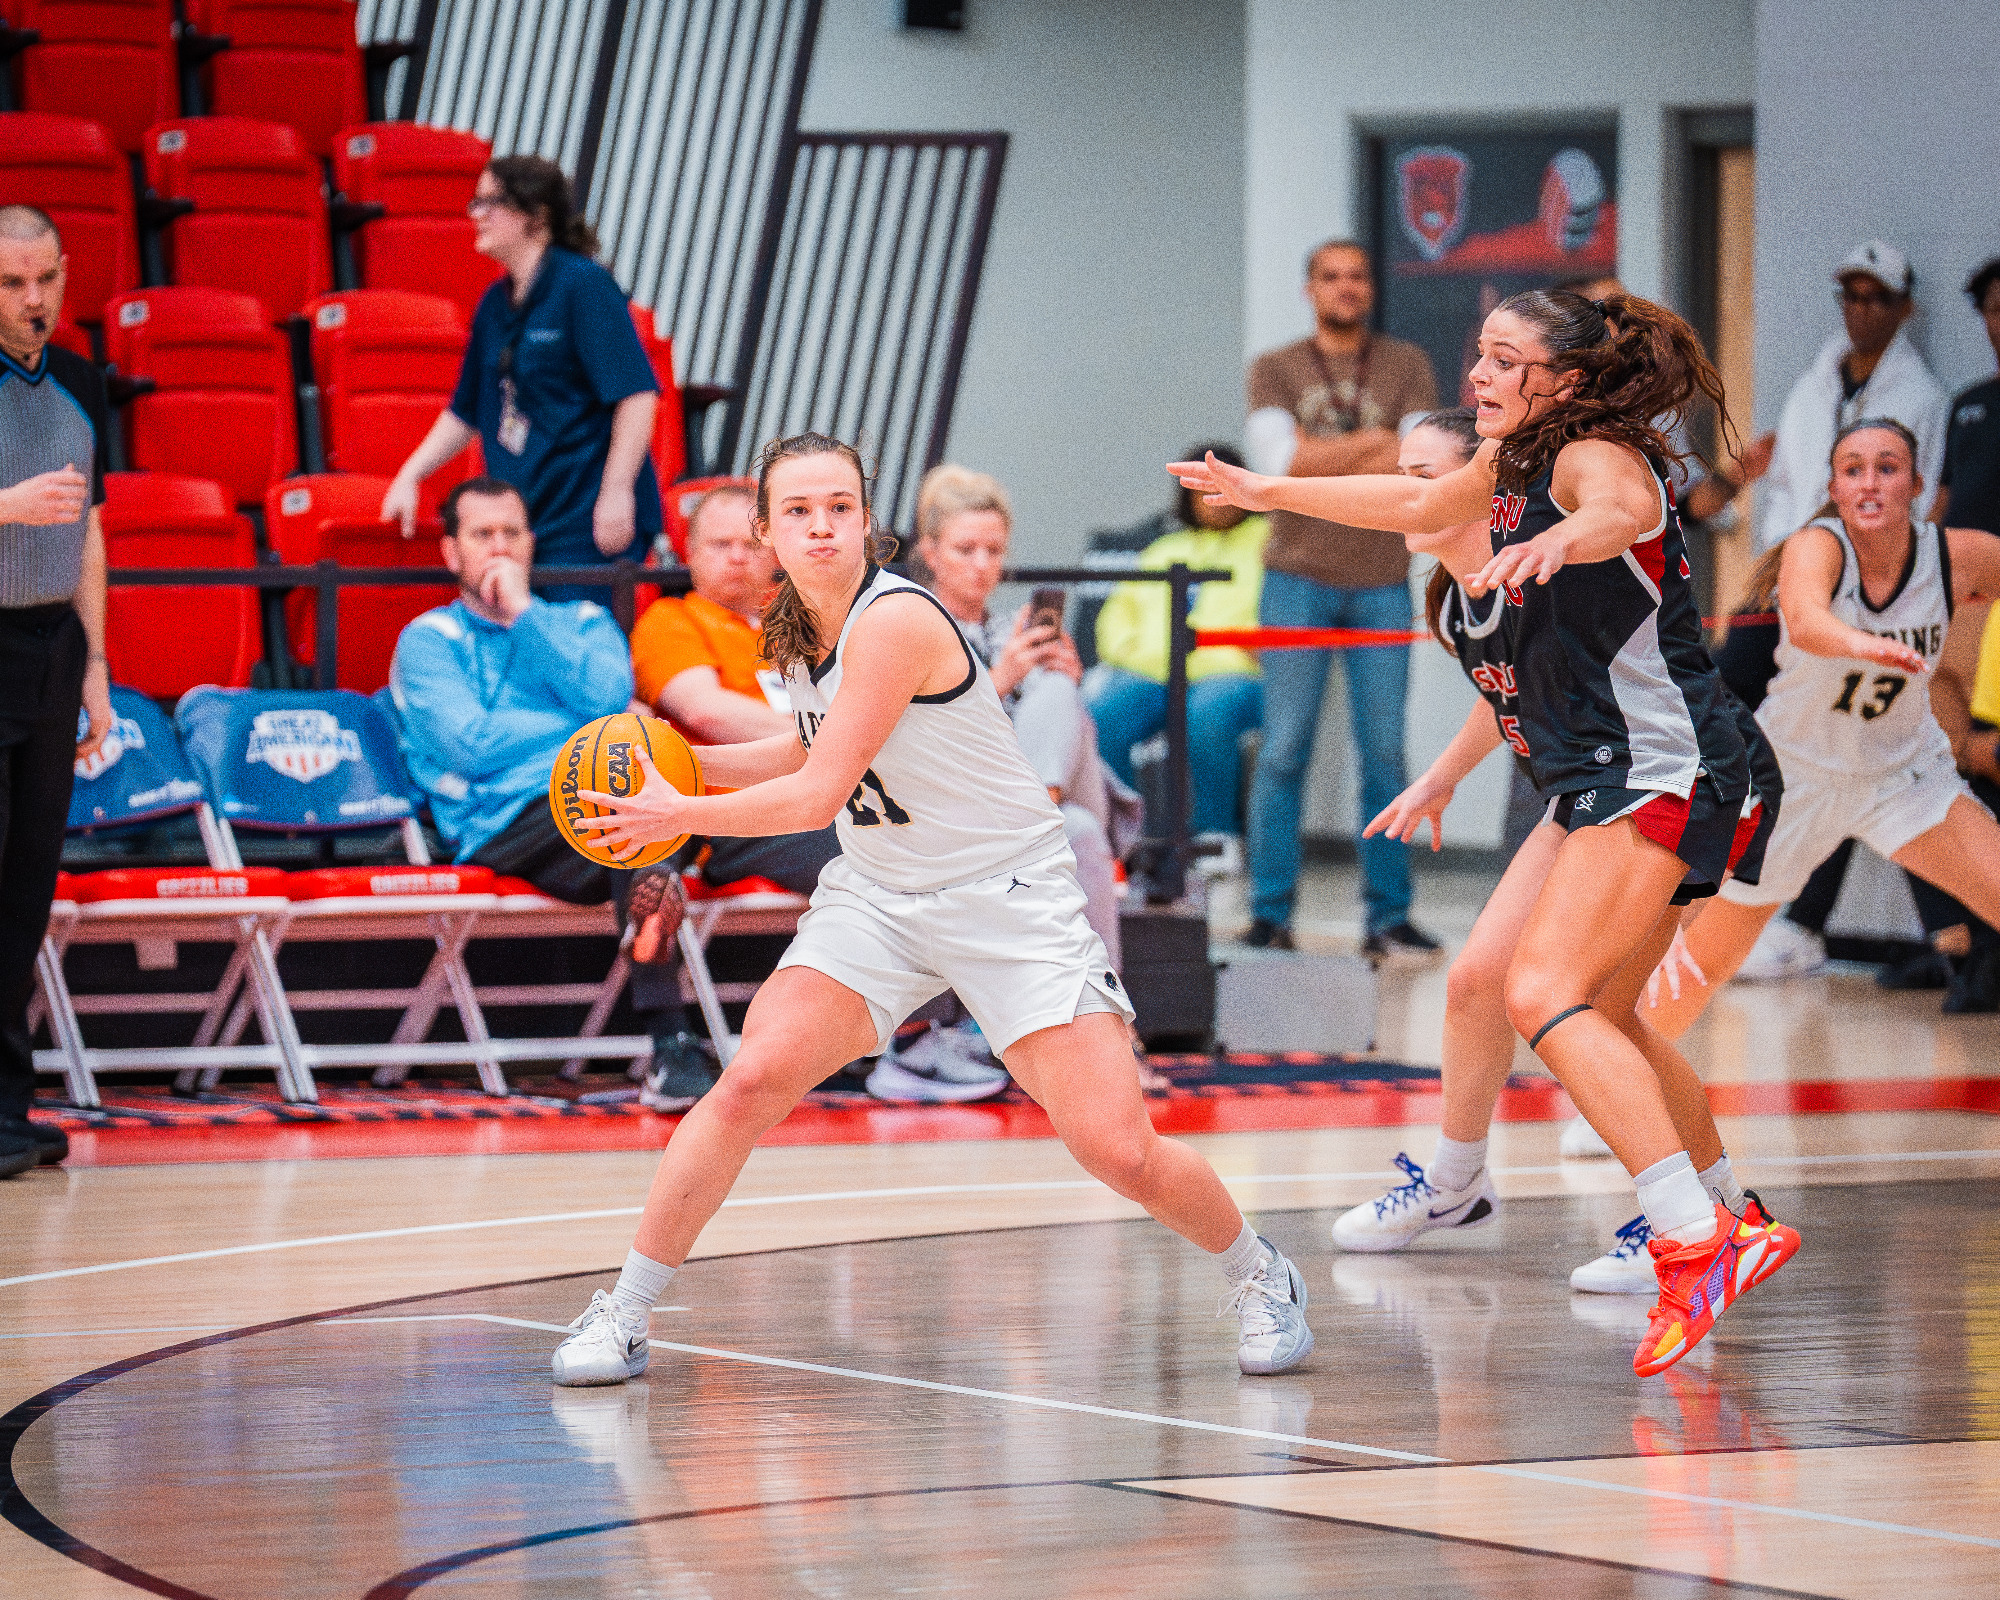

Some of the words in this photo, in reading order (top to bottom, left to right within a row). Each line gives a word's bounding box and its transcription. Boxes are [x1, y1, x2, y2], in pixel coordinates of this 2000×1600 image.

[1489, 489, 1528, 541] SNU
[1472, 660, 1519, 705] SNU
[1831, 669, 1908, 721] 13
[561, 735, 591, 838] Wilson
[608, 742, 632, 815] CAA
